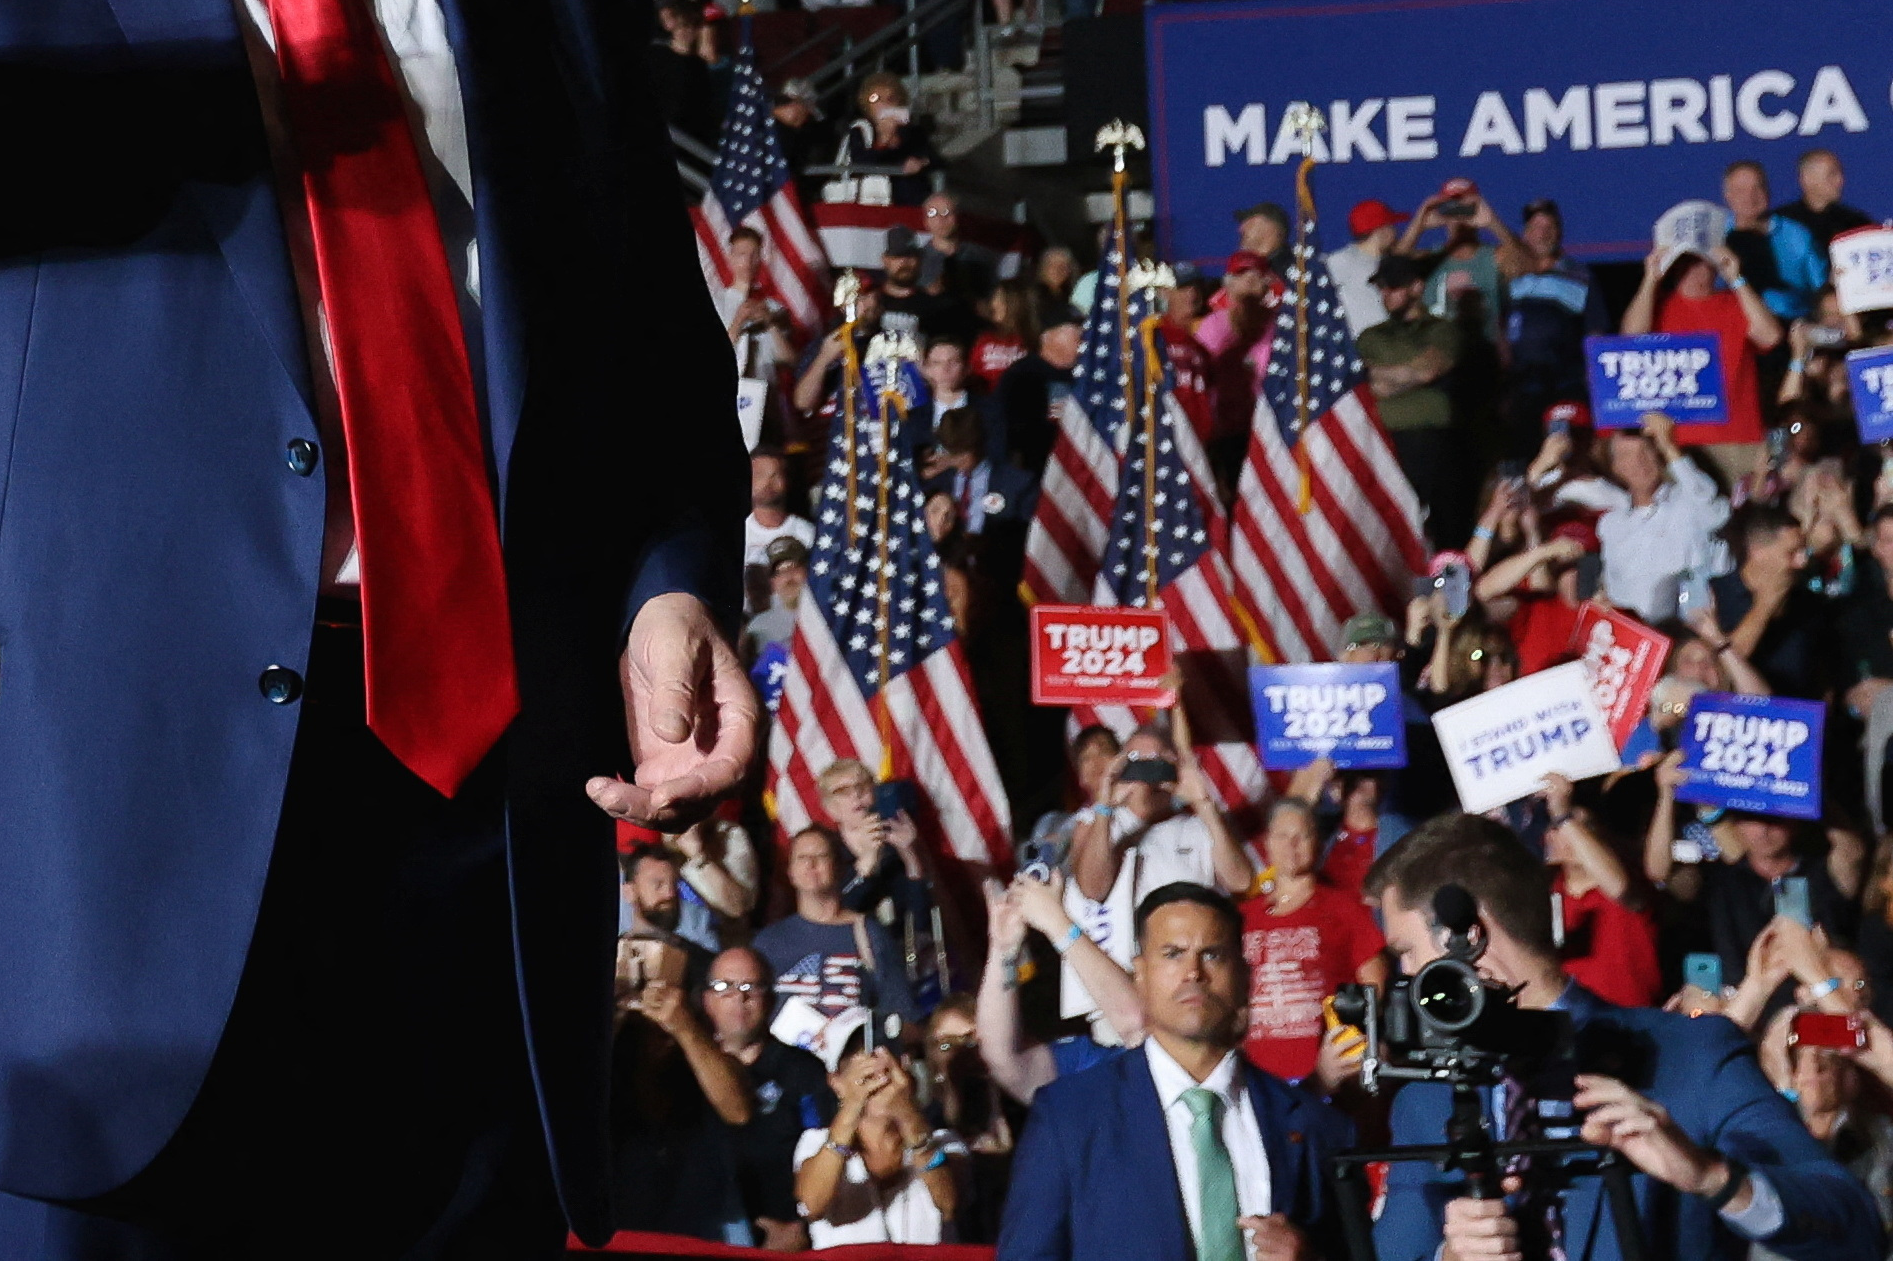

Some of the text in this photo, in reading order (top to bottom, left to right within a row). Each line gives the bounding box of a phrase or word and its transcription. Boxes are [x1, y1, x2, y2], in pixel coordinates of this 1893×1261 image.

[1204, 66, 1869, 167] MAKE AMERICA
[1597, 347, 1711, 378] TRUMP
[1617, 370, 1700, 400] 2024
[1044, 623, 1160, 651] TRUMP
[1061, 650, 1146, 676] 2024
[1263, 682, 1387, 714] TRUMP
[1283, 710, 1374, 738] 2024
[1694, 711, 1810, 750] TRUMP
[1464, 716, 1591, 780] TRUMP
[1700, 740, 1791, 779] 2024
